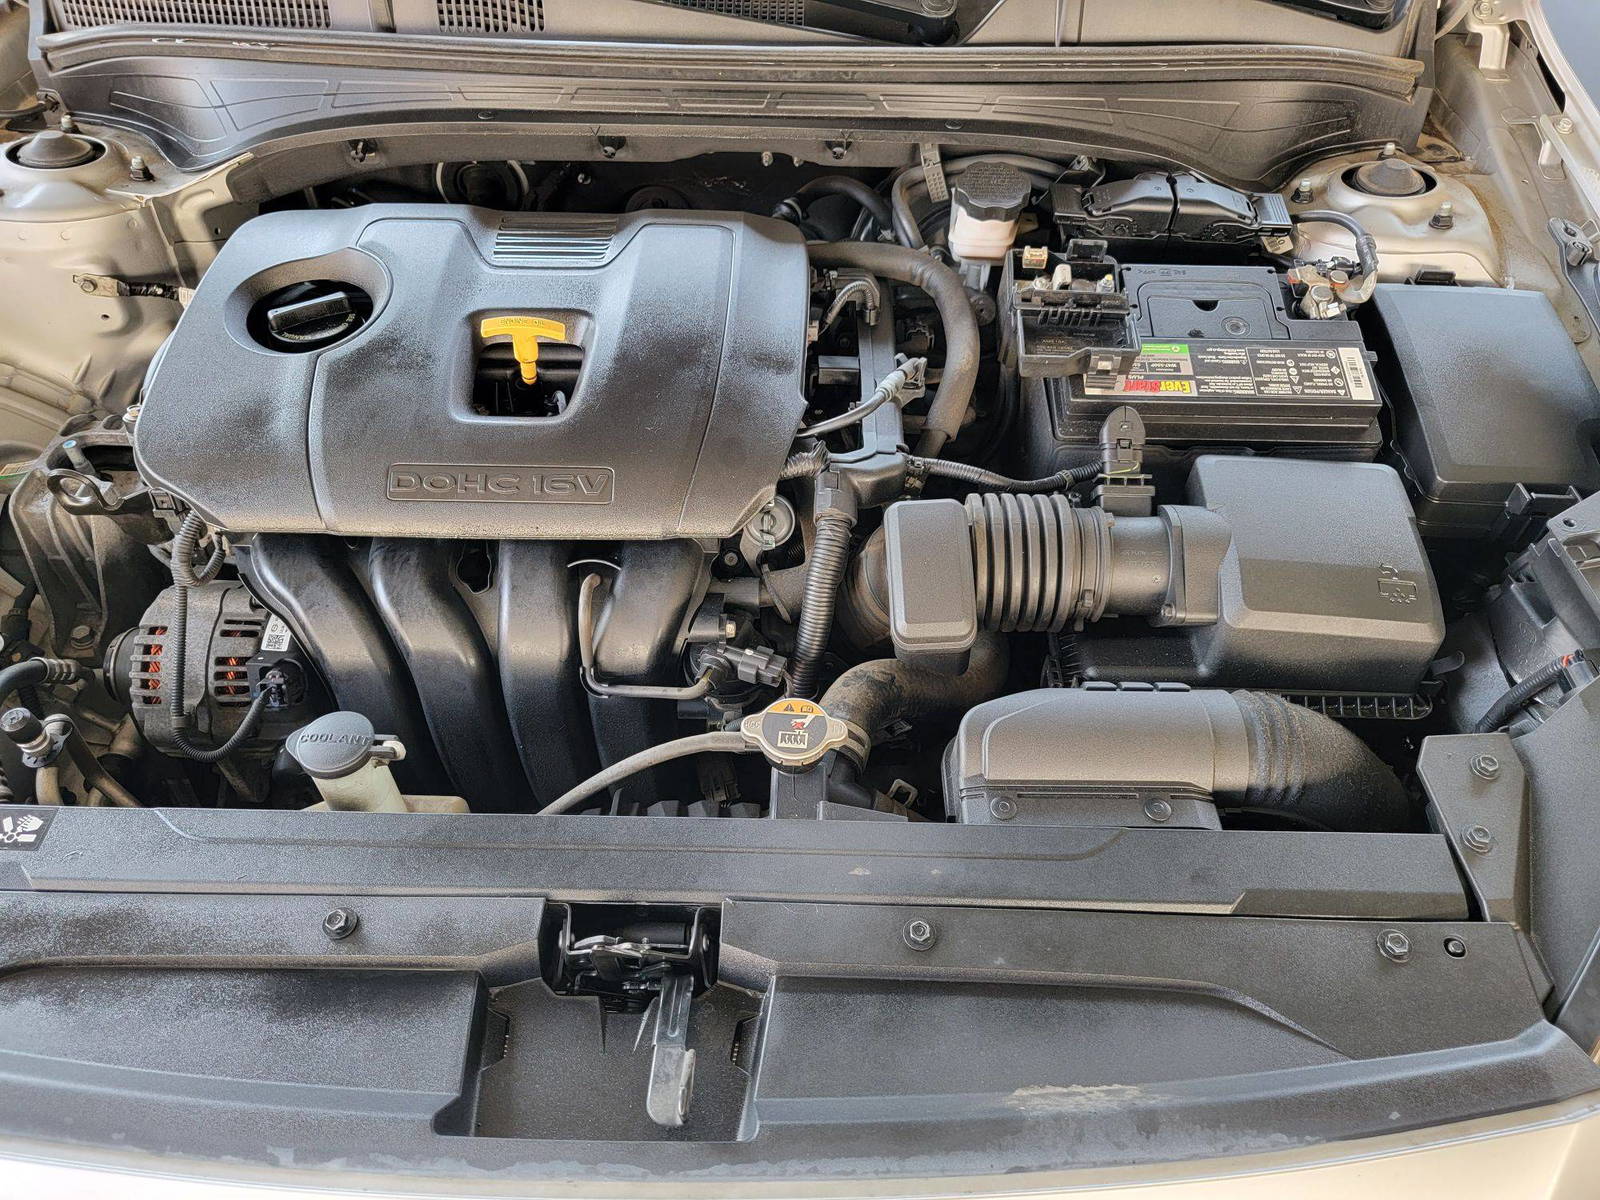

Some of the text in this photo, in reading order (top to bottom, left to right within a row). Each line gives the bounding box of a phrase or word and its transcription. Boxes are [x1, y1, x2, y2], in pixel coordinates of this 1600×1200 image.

[1124, 380, 1191, 394] EverStart
[389, 472, 610, 496] DOHC 16V
[300, 733, 373, 746] COOLANT
